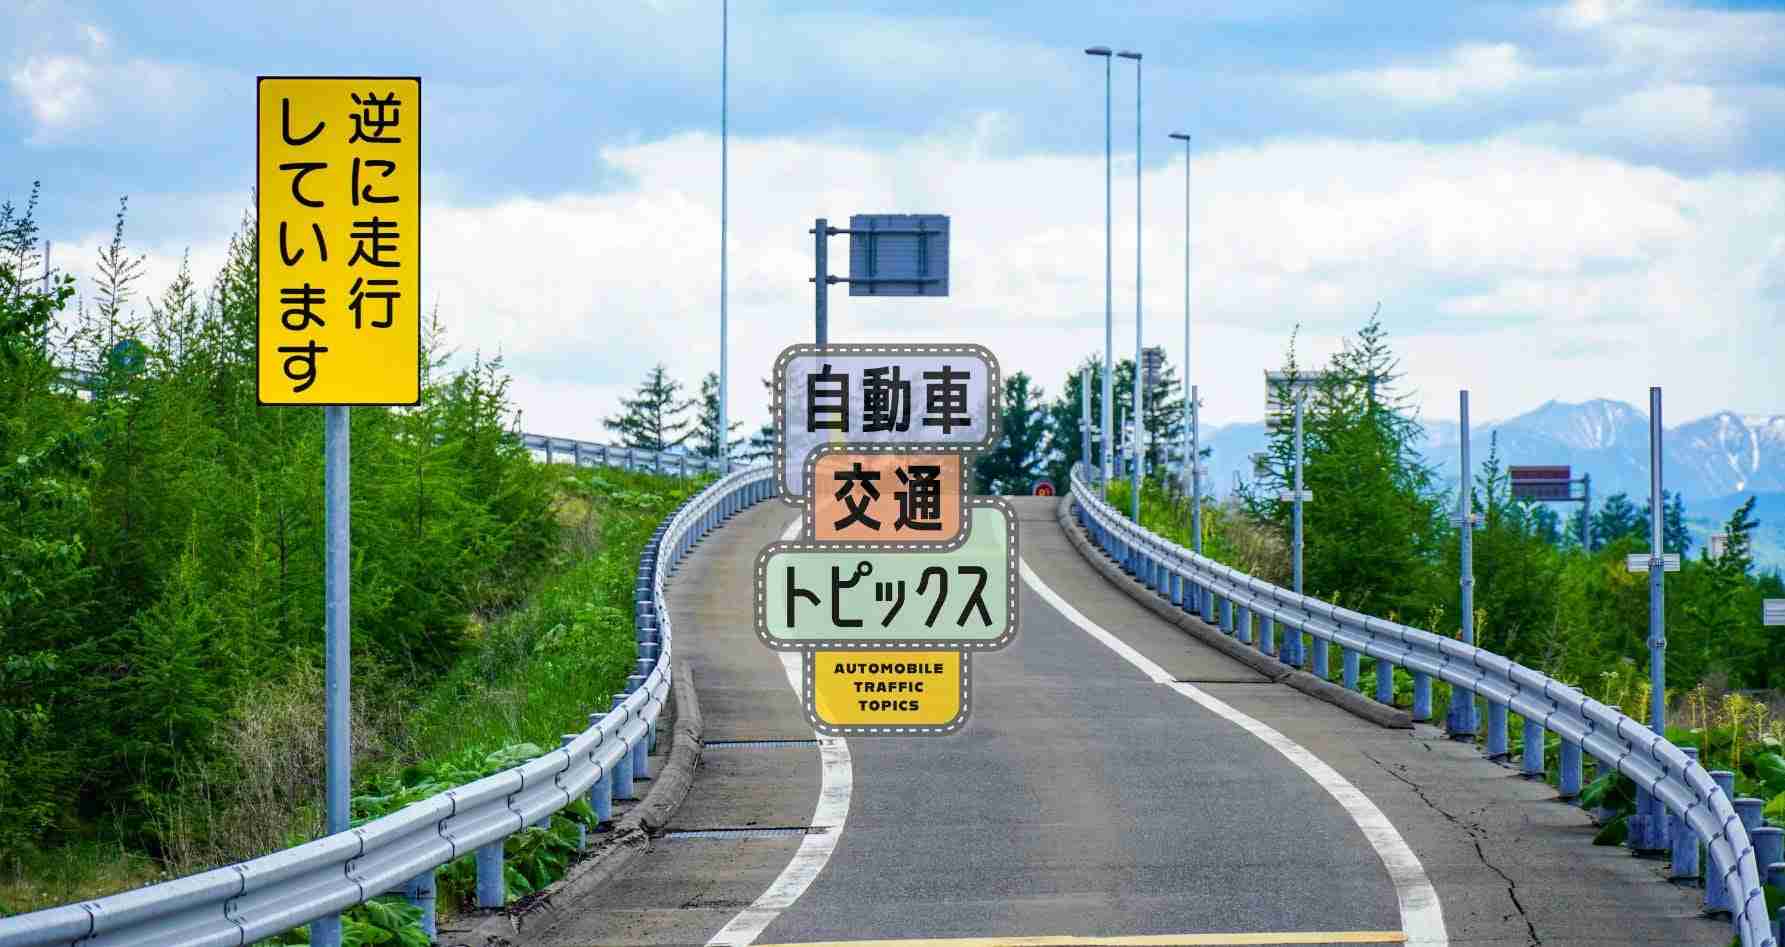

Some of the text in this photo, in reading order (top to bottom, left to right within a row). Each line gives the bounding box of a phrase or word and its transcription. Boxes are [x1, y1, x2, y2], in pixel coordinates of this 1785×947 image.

[277, 97, 329, 394] しています
[348, 91, 402, 330] 逆に走行
